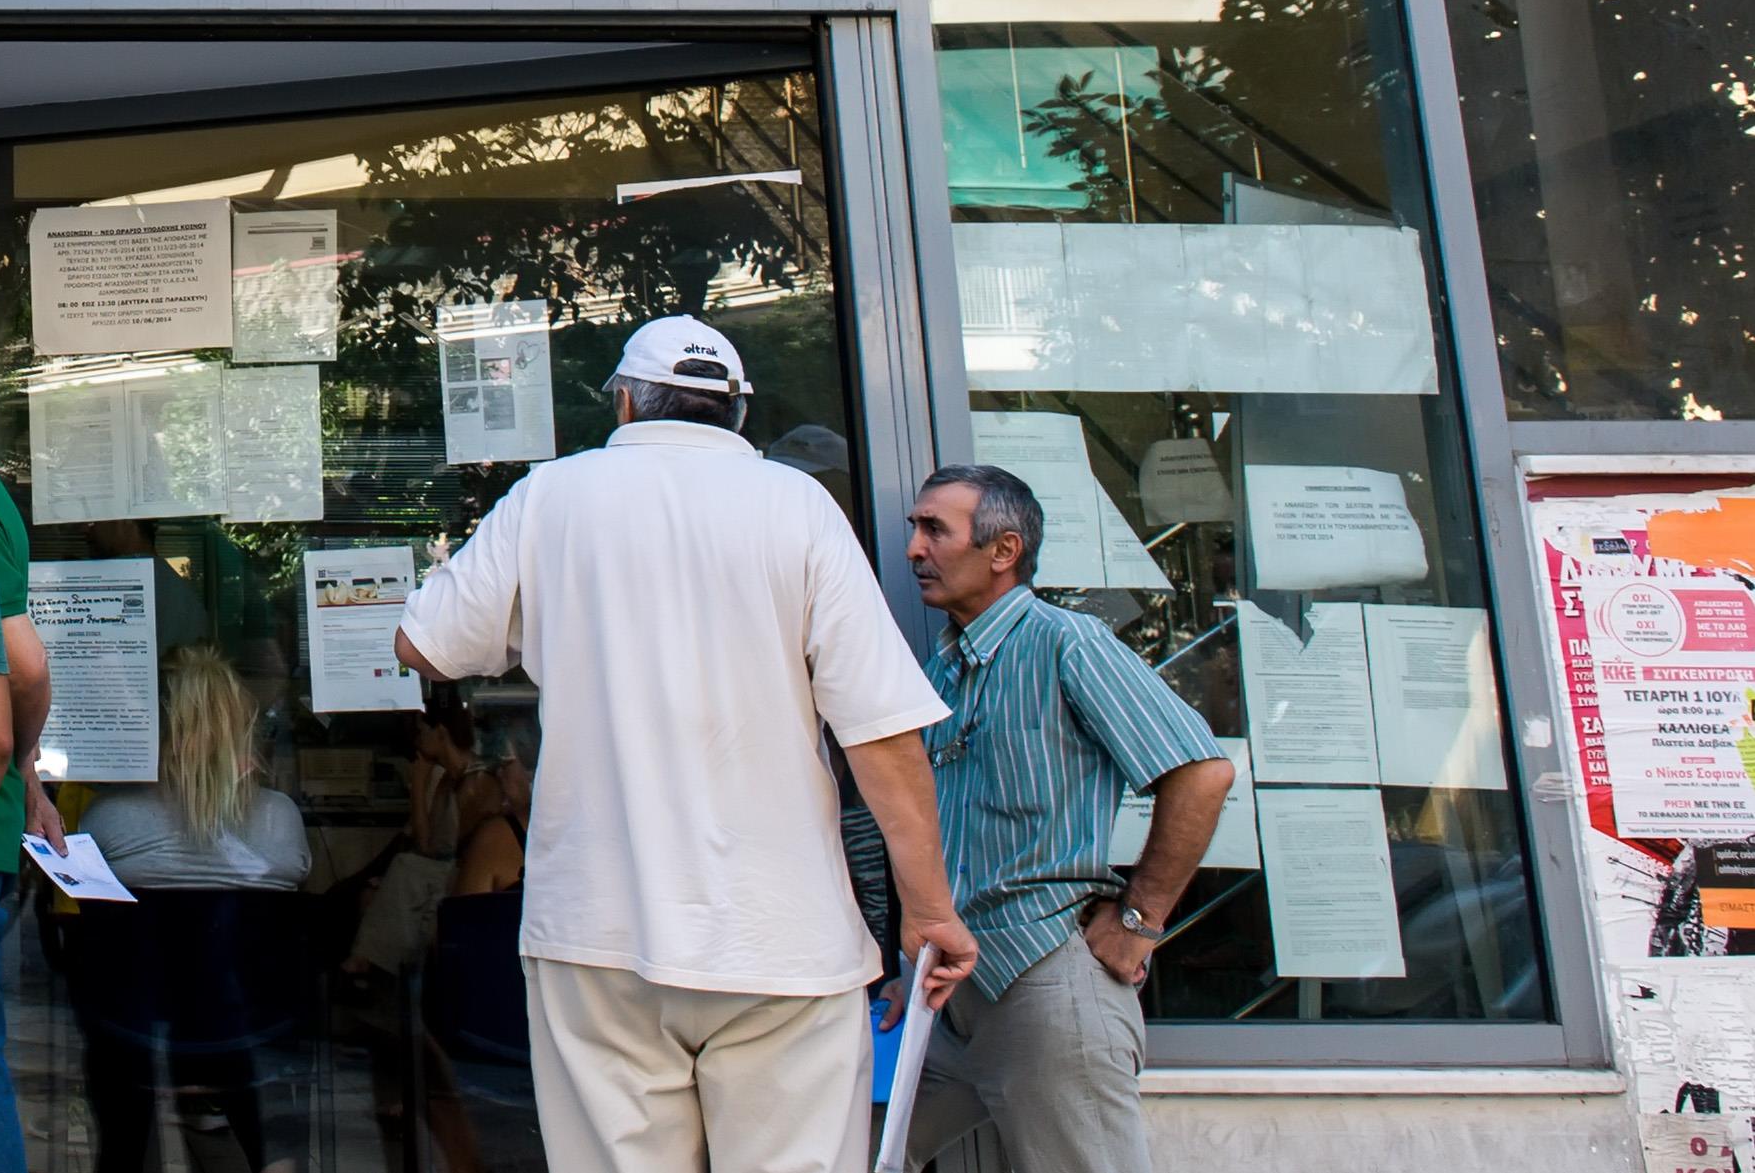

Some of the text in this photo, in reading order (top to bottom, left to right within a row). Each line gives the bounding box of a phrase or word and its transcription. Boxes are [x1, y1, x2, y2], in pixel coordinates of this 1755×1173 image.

[1632, 594, 1651, 603] ΟΧΙ
[1636, 620, 1655, 629] ΟΧΙ
[1601, 665, 1754, 681] ΚΚΕ ΣΥΓΚΕΝΤΡΩΣΗ
[1624, 690, 1688, 703] ΤΕΤΑΡΤΗ
[1693, 690, 1702, 702] 1
[1681, 706, 1704, 714] 8:00
[1658, 723, 1730, 734] ΚΑΛΛΙΘΕΑ
[1652, 737, 1735, 748] Πλατεία Δαβάκ
[1656, 767, 1693, 779] Νίκος
[1663, 800, 1746, 809] ΡΗΞΗ ΜΕ ΤΗΝ ΕΕ
[1649, 811, 1689, 819] ΚΕΦΑΛΑΙΟ
[1691, 811, 1704, 819] ΚΑΙ
